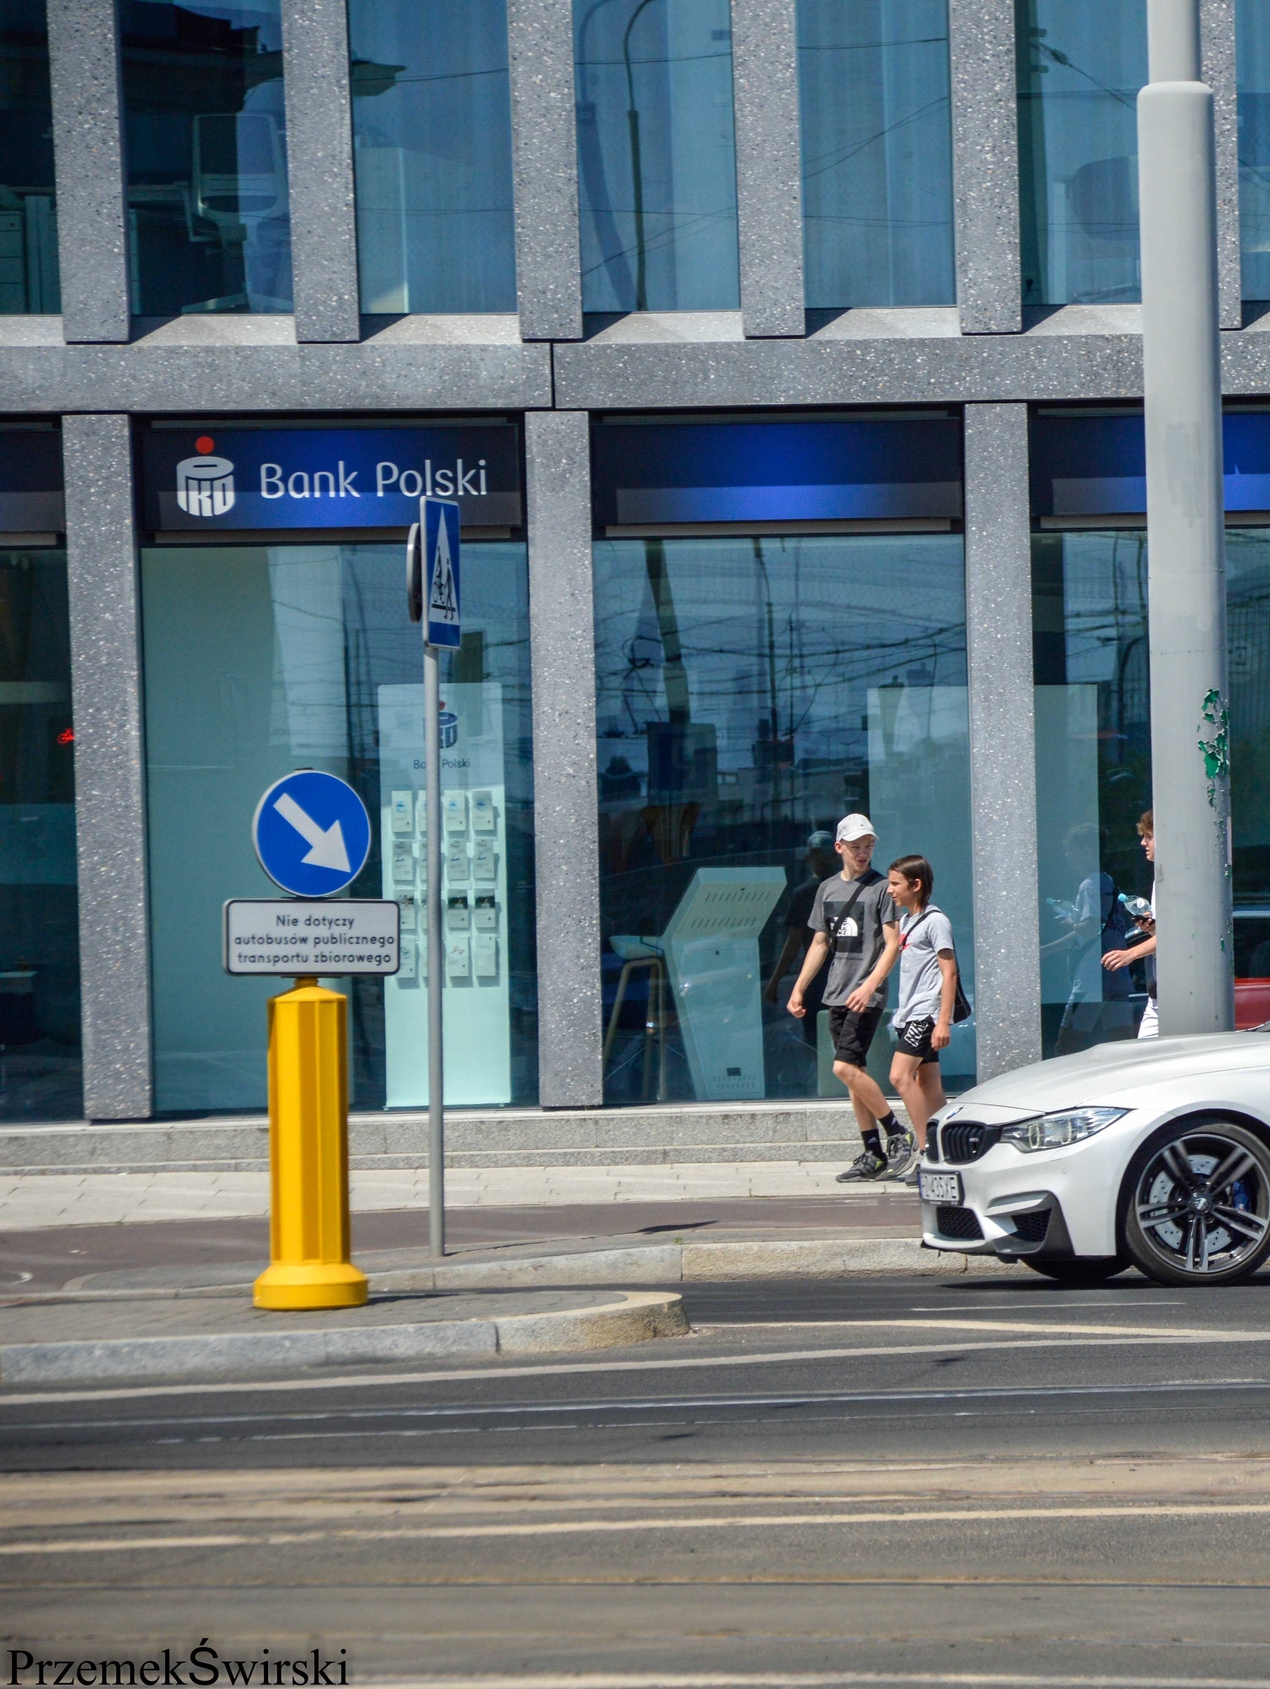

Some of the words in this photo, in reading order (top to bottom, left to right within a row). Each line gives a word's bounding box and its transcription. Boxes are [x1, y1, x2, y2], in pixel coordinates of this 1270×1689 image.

[259, 460, 360, 498] Bank
[376, 459, 487, 497] Polski
[442, 758, 470, 769] Polski
[275, 914, 299, 927] Nie
[304, 914, 355, 930] dotyczy
[233, 932, 308, 945] autobusów
[313, 932, 395, 948] publicznego
[237, 951, 309, 966] transportu
[313, 951, 391, 966] zbiorowego
